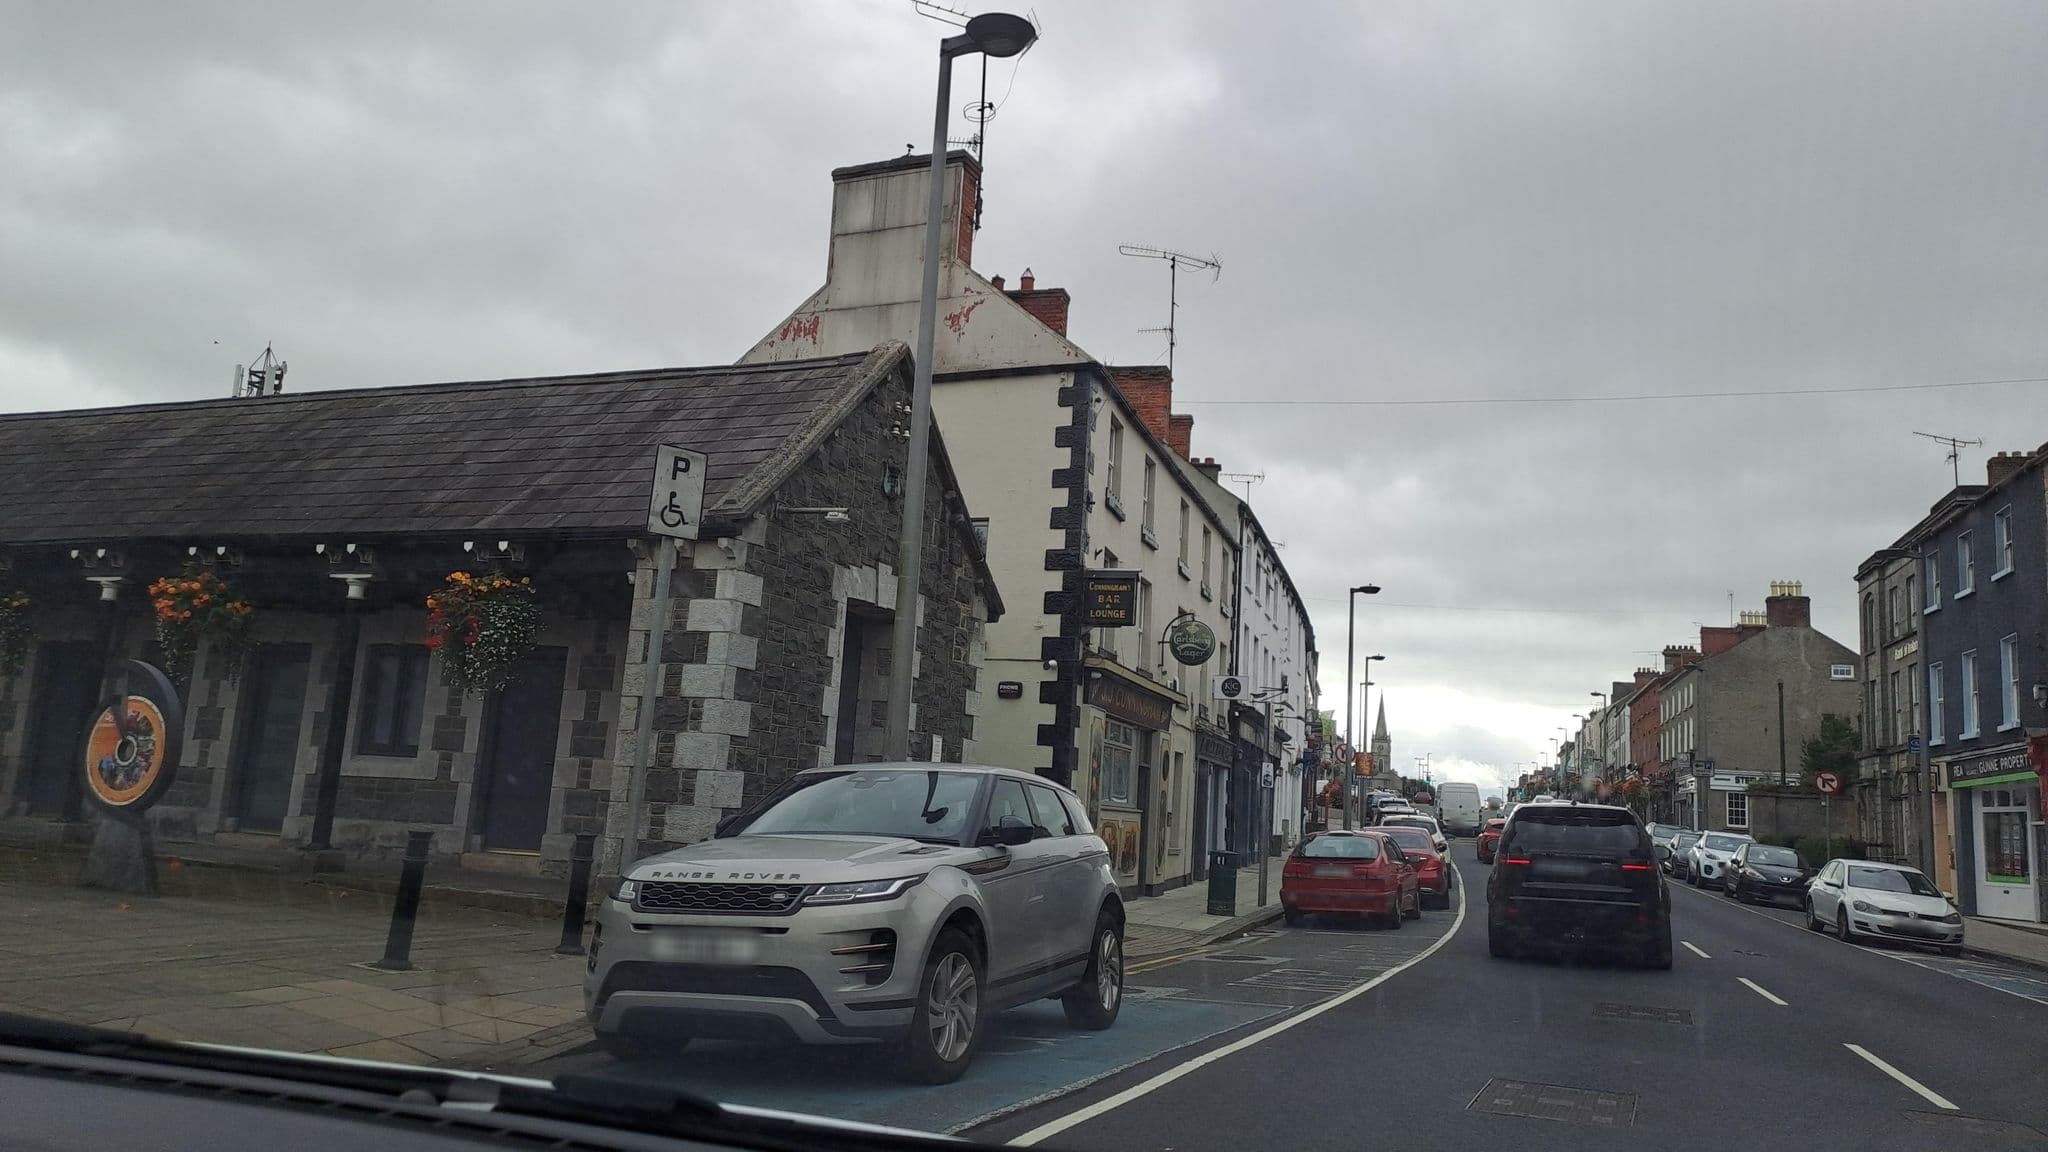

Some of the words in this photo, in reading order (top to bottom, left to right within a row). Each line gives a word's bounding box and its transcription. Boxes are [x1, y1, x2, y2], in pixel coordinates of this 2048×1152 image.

[671, 455, 691, 481] P
[1097, 594, 1121, 604] BAR
[1090, 609, 1126, 619] LOUNGE
[2000, 753, 2032, 770] PROPERT
[651, 871, 716, 880] RANGE
[729, 872, 801, 881] ROVER
